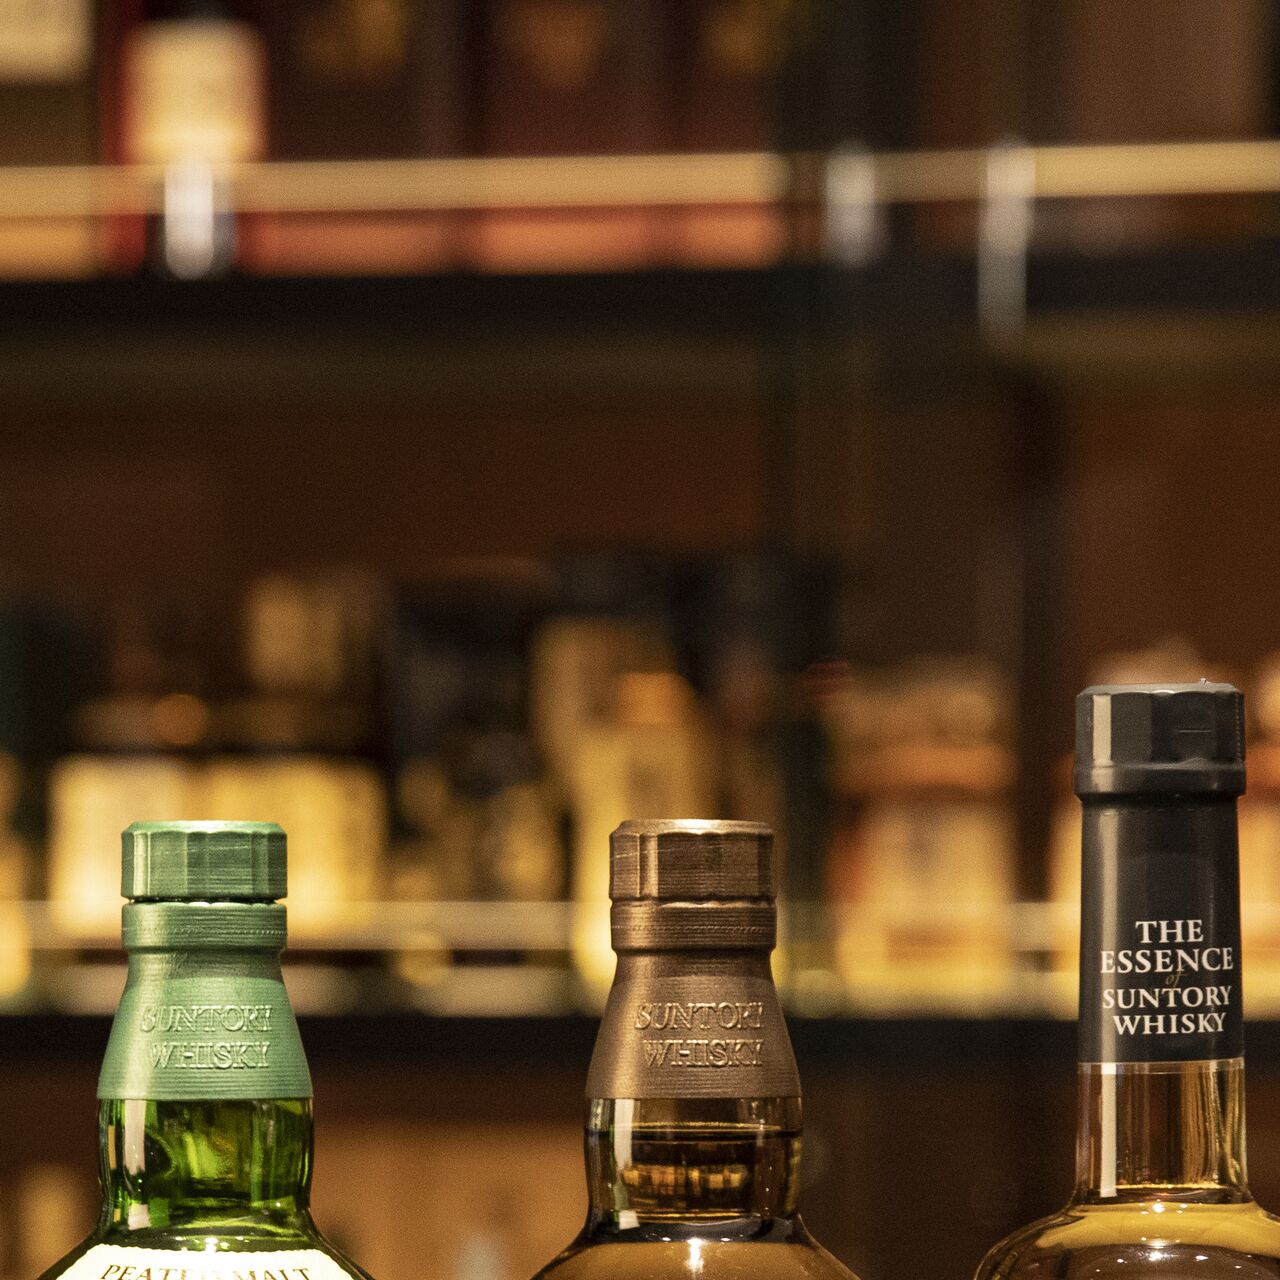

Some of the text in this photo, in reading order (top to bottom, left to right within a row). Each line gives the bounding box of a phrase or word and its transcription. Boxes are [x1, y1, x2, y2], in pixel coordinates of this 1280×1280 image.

[1135, 920, 1204, 943] THE
[1100, 948, 1233, 973] ESSENCE
[1102, 986, 1231, 1008] SUNTORY
[1112, 1013, 1226, 1035] WHISKY
[151, 1041, 271, 1070] WHISKY
[641, 1039, 764, 1067] WHISKY
